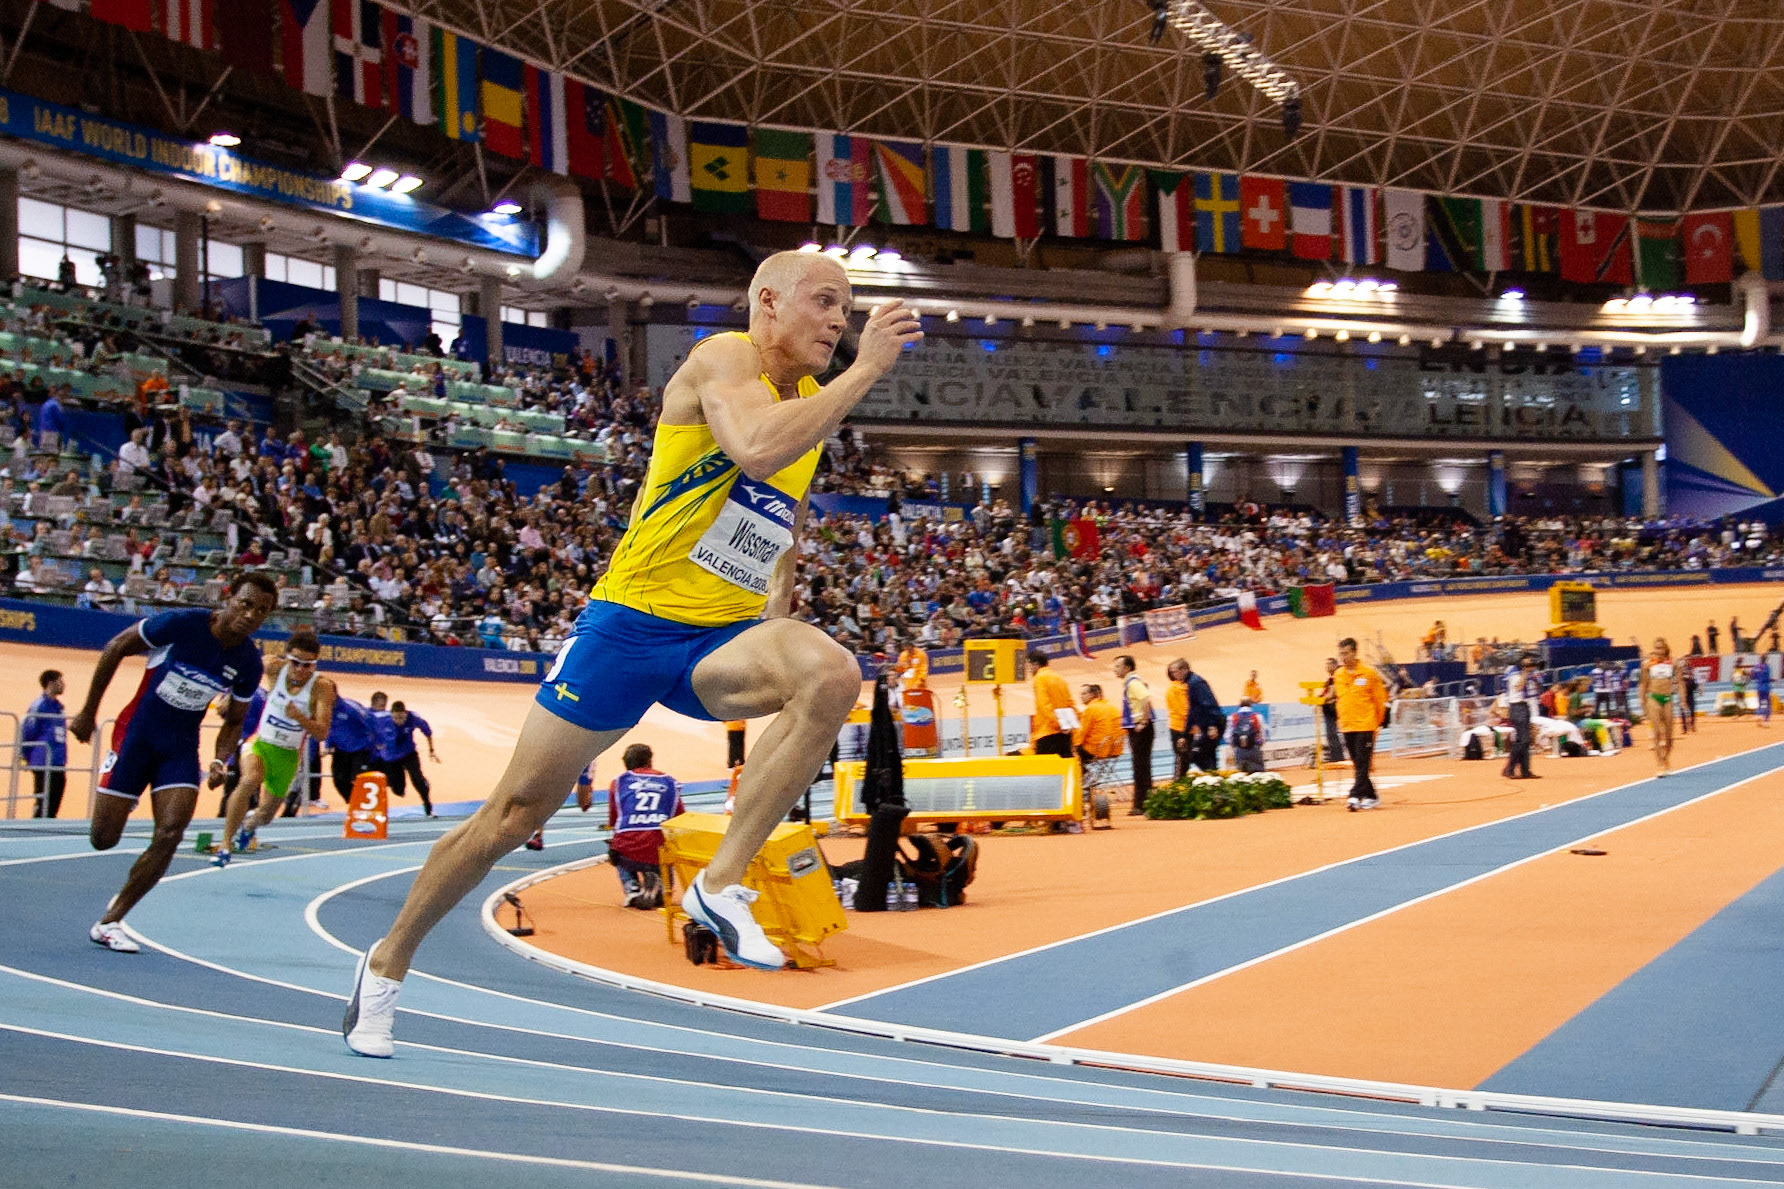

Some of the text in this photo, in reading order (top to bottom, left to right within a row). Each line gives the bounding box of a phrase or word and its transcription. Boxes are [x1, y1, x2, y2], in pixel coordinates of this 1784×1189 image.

[34, 105, 77, 141] IAAF
[80, 118, 148, 158] WORLD
[217, 152, 354, 209] CHAMPIONSHIPS
[696, 546, 751, 587] VALENCIA
[360, 781, 380, 811] 3
[635, 791, 662, 811] 27
[628, 813, 669, 825] IAAF
